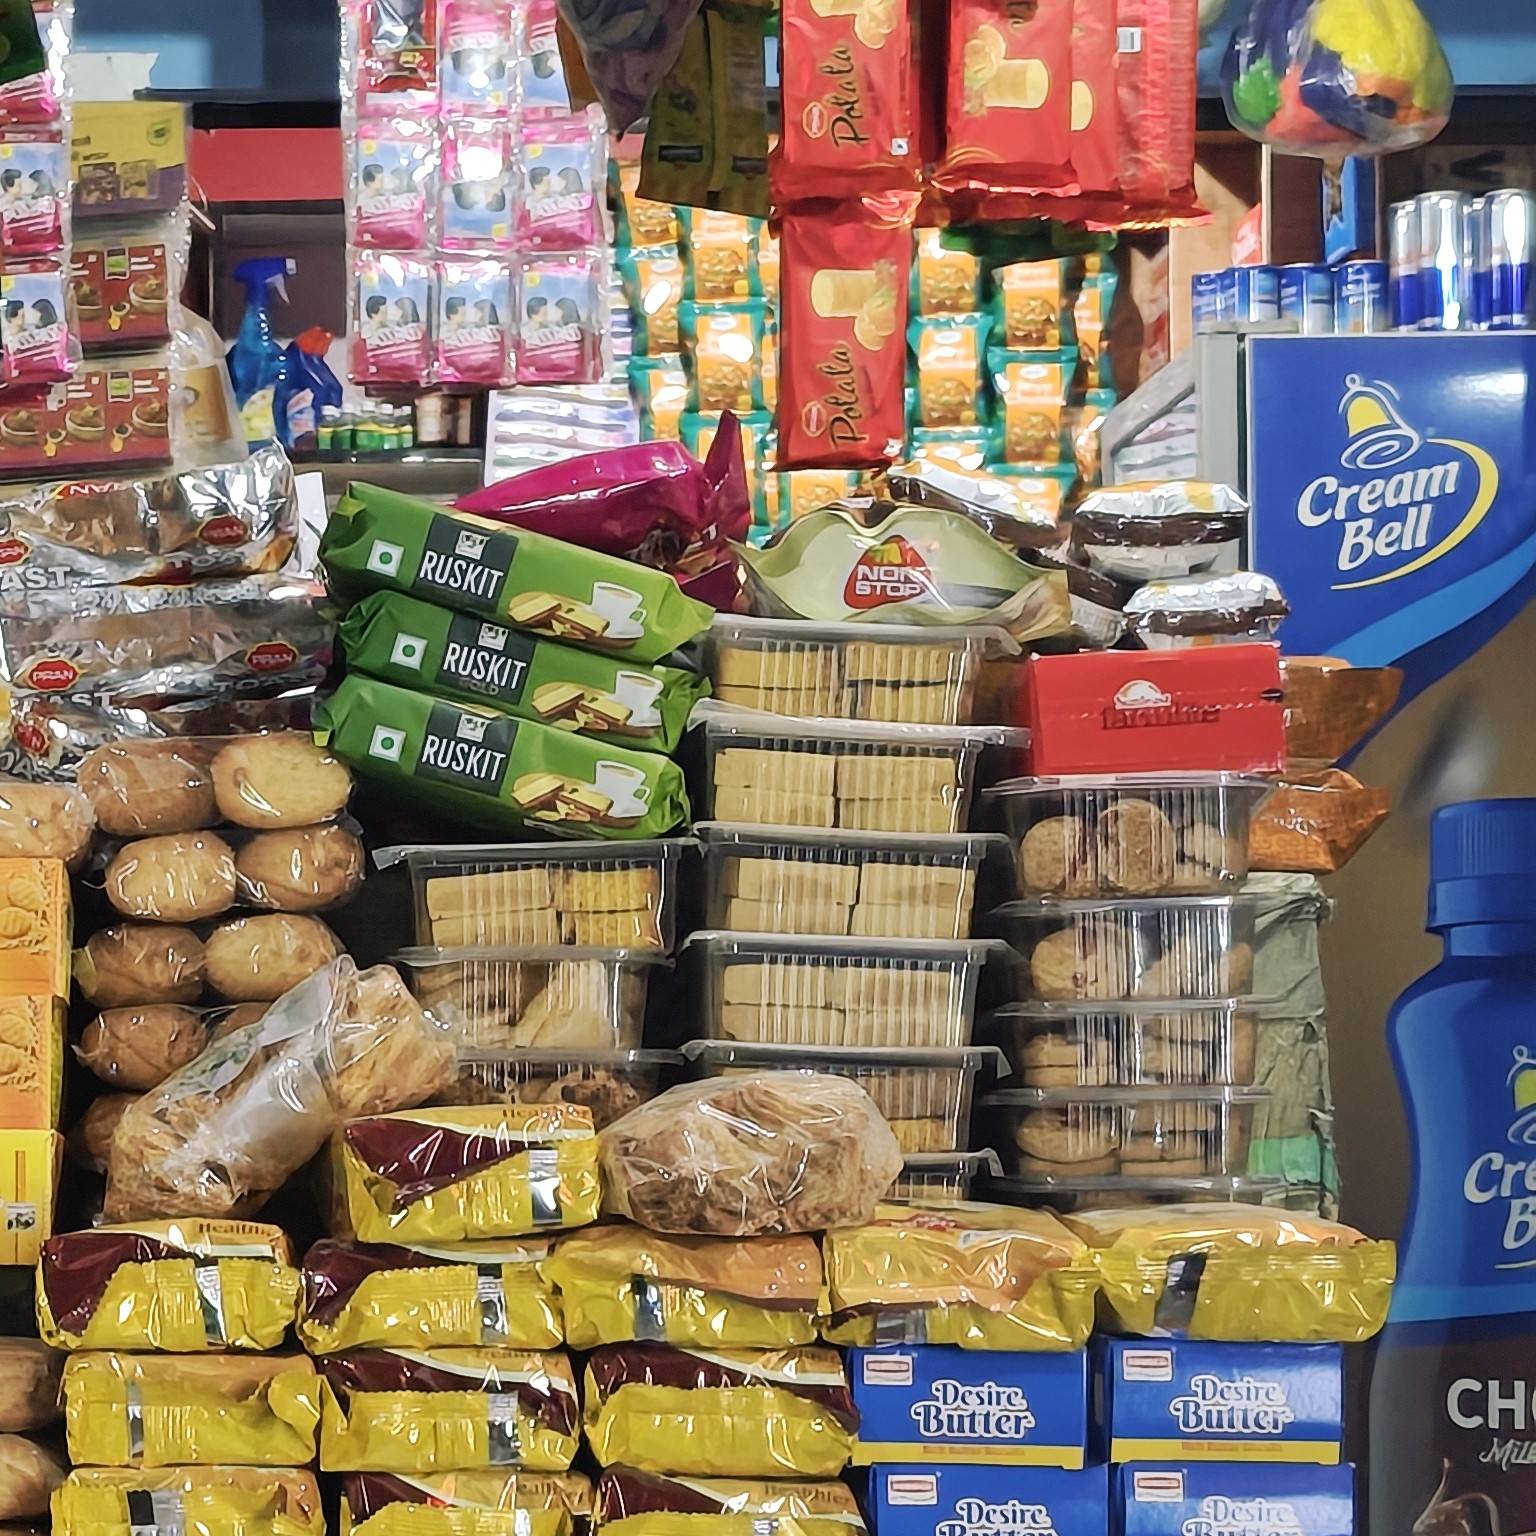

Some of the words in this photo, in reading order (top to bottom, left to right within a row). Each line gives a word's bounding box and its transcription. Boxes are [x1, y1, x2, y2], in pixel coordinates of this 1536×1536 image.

[1297, 460, 1462, 528] Cream
[1336, 502, 1435, 572] Bell
[419, 549, 505, 601] RUSKIT
[855, 582, 926, 598] STOP
[442, 640, 528, 692] RUSKIT
[422, 733, 507, 783] RUSKIT
[1463, 1150, 1536, 1205] Cre
[931, 1379, 1027, 1408] Desire
[1191, 1373, 1287, 1404] Desire
[909, 1399, 1036, 1439] Butter
[1169, 1395, 1295, 1434] Butter
[955, 1497, 1052, 1527] Desire
[1201, 1495, 1297, 1524] Desire
